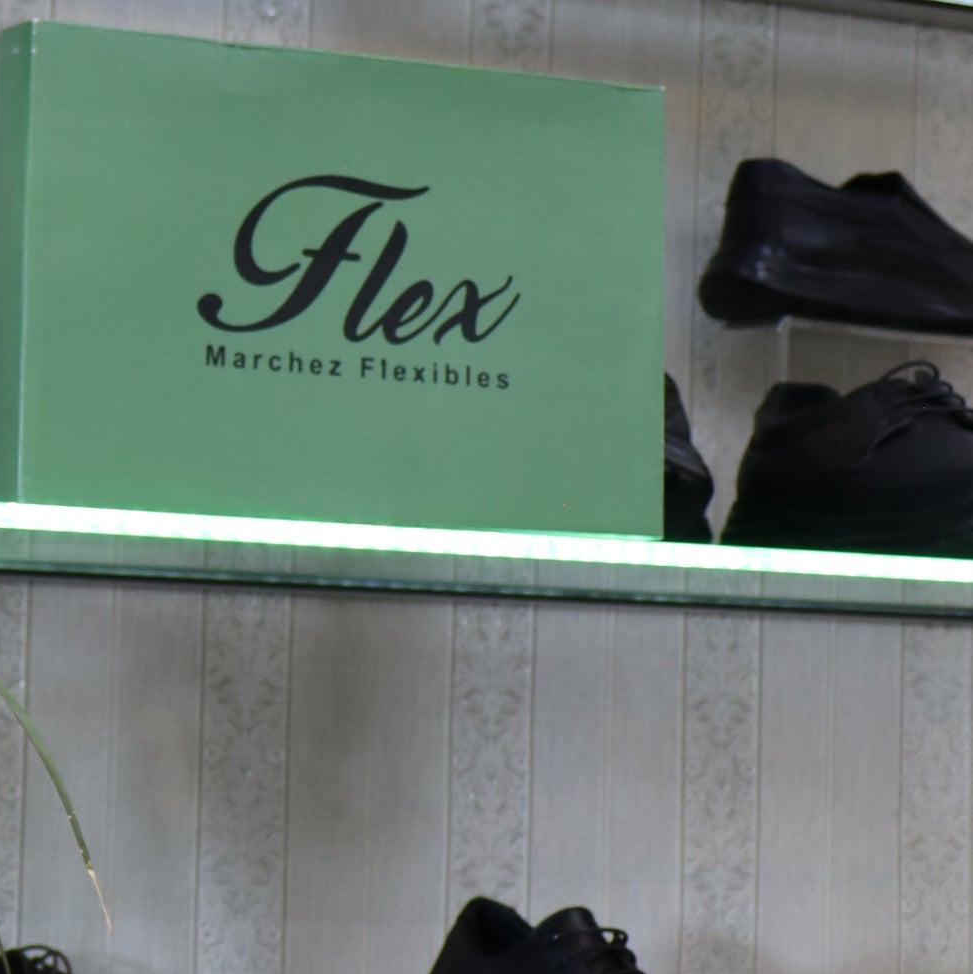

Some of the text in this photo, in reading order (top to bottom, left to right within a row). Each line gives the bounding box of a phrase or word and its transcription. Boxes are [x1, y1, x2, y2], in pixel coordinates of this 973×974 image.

[196, 174, 521, 346] Flex
[205, 343, 510, 390] Marchez Flexibles
